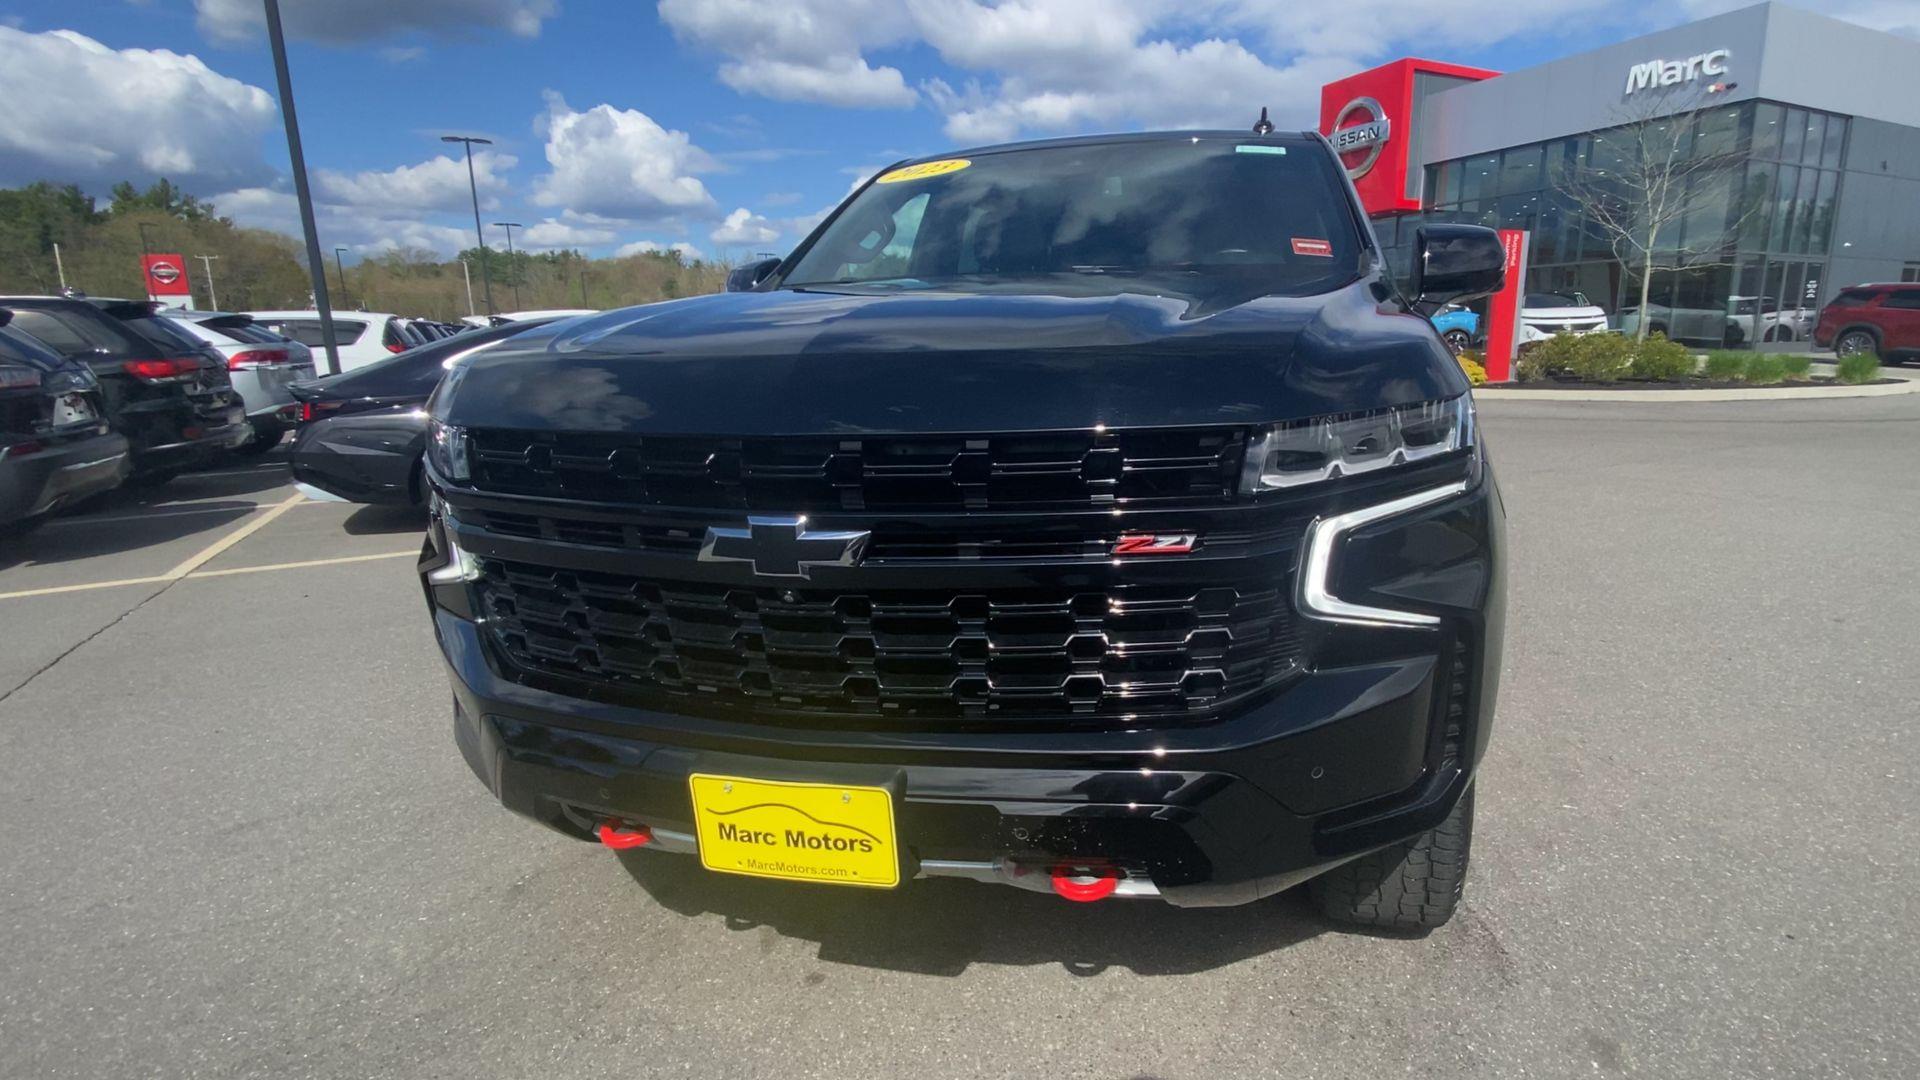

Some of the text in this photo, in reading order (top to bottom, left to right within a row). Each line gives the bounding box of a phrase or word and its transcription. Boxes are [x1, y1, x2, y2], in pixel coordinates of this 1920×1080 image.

[1626, 49, 1731, 95] Marc
[718, 822, 873, 853] Marc Motors
[747, 858, 848, 877] MarcMotors.com
